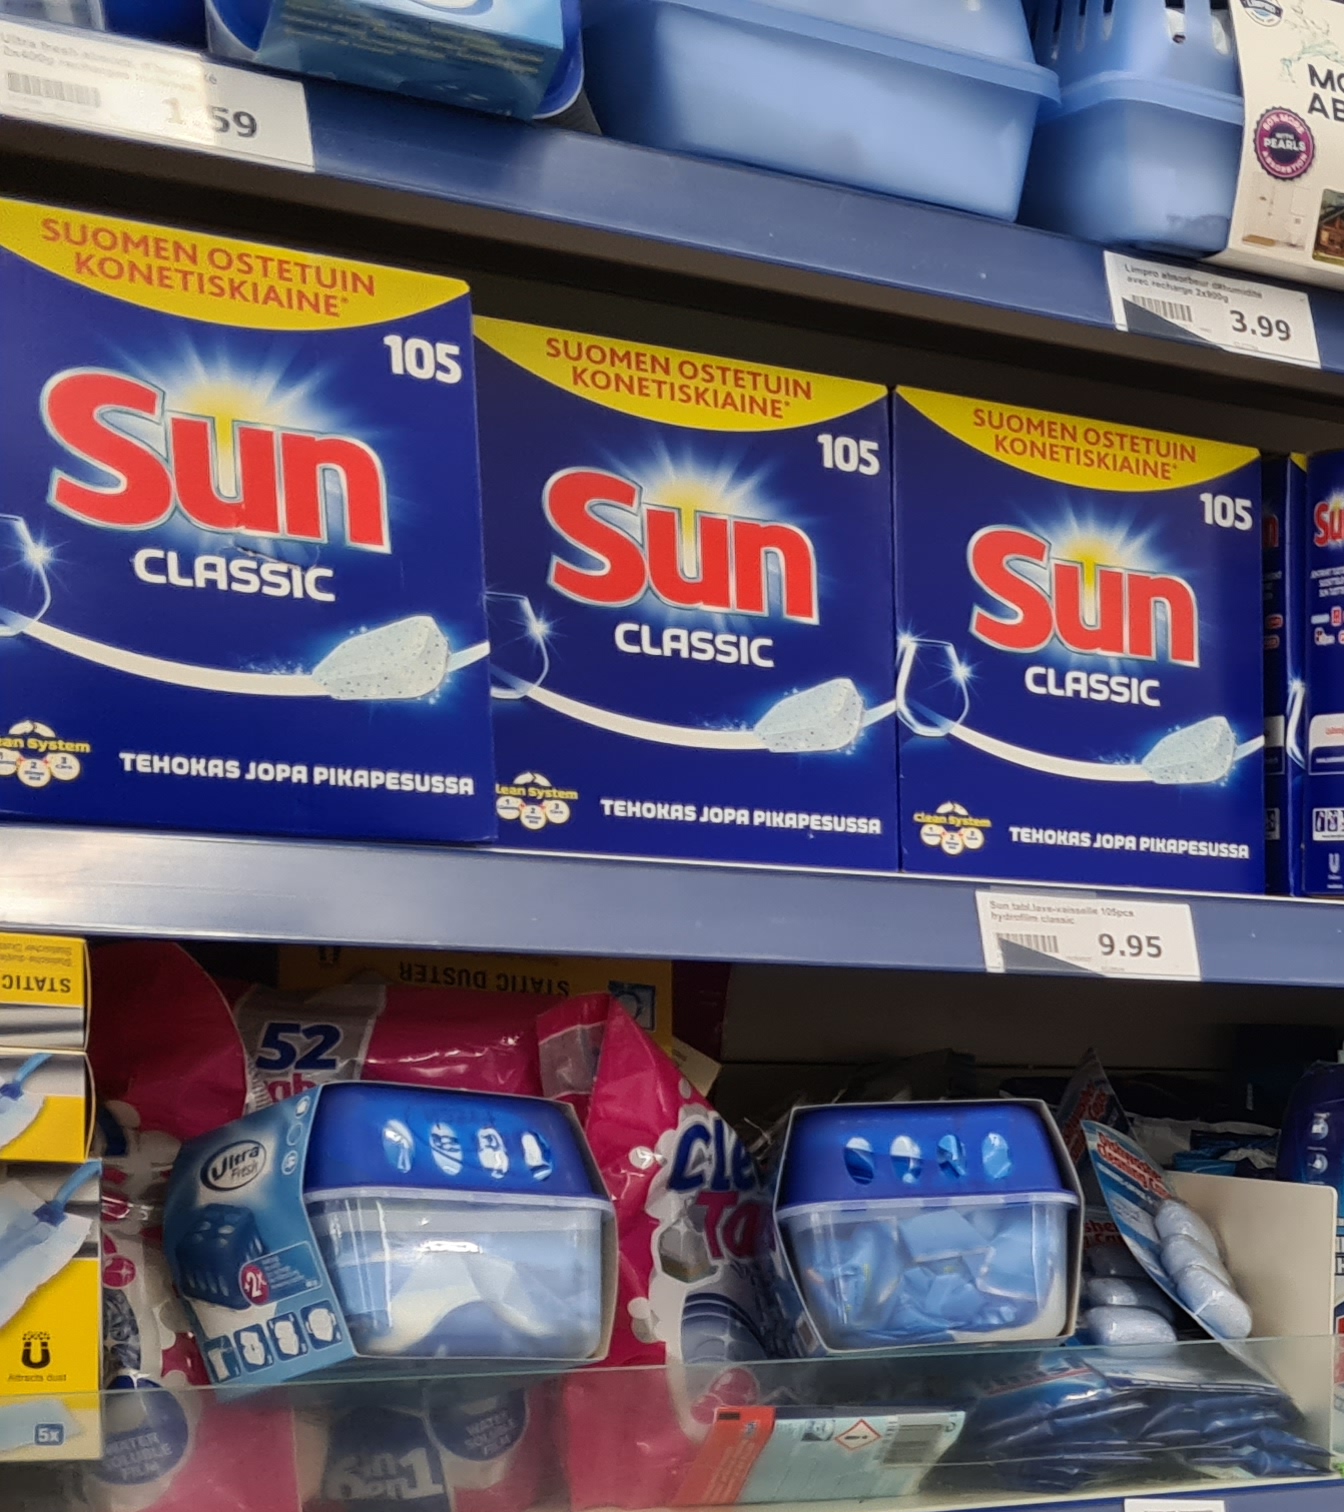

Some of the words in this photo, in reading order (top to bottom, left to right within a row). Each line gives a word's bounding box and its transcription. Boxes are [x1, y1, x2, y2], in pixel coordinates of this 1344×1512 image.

[41, 218, 200, 267] SUOMEN
[207, 247, 376, 297] OSTETUIN
[1125, 264, 1159, 278] Limpro
[1127, 276, 1149, 286] avec
[1152, 279, 1193, 295] recharge
[1230, 310, 1291, 341] 3.99
[383, 334, 462, 384] 105
[546, 337, 671, 377] SUOMEN
[678, 360, 813, 400] OSTETUIN
[40, 366, 392, 554] Sun
[817, 434, 880, 475] 105
[1199, 493, 1253, 531] 105
[542, 466, 819, 625] Sun
[133, 548, 336, 602] CLASSIC
[967, 524, 1199, 668] Sun
[614, 622, 775, 668] CLASSIC
[1024, 666, 1161, 707] CLASSIC
[119, 751, 241, 780] TEHOKAS
[243, 761, 309, 783] JOPA
[313, 765, 475, 796] PIKAPESUSSA
[600, 798, 698, 822] TEHOKAS
[699, 806, 750, 826] JOPA
[753, 811, 881, 835] PIKAPESUSSA
[1097, 933, 1163, 959] 9.95
[398, 962, 488, 990] DUSTER
[500, 971, 571, 996] STATIC
[254, 1022, 344, 1072] 52
[207, 1146, 261, 1184] Ultra
[230, 1160, 259, 1180] Fresh
